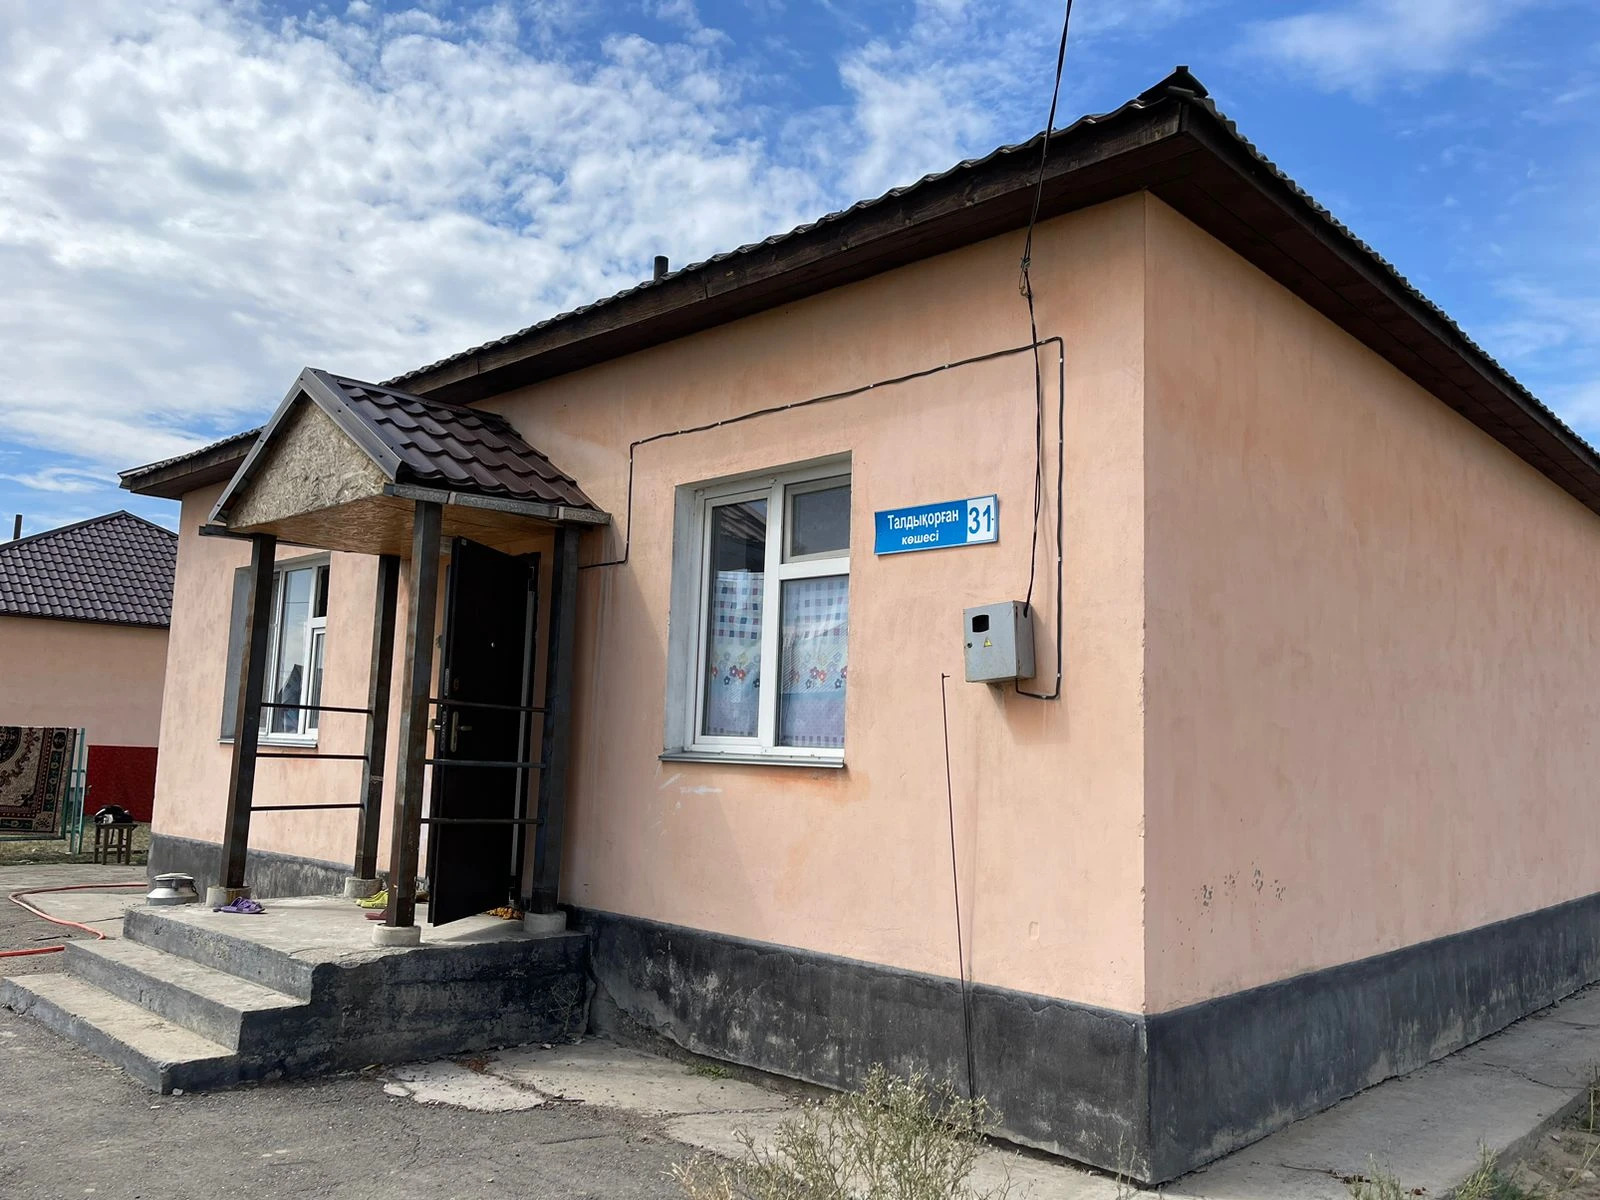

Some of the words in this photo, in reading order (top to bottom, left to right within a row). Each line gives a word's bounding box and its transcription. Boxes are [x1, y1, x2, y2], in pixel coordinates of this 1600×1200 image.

[887, 509, 959, 531] Талдықорған
[968, 504, 991, 535] 31
[901, 530, 940, 545] көшесі
